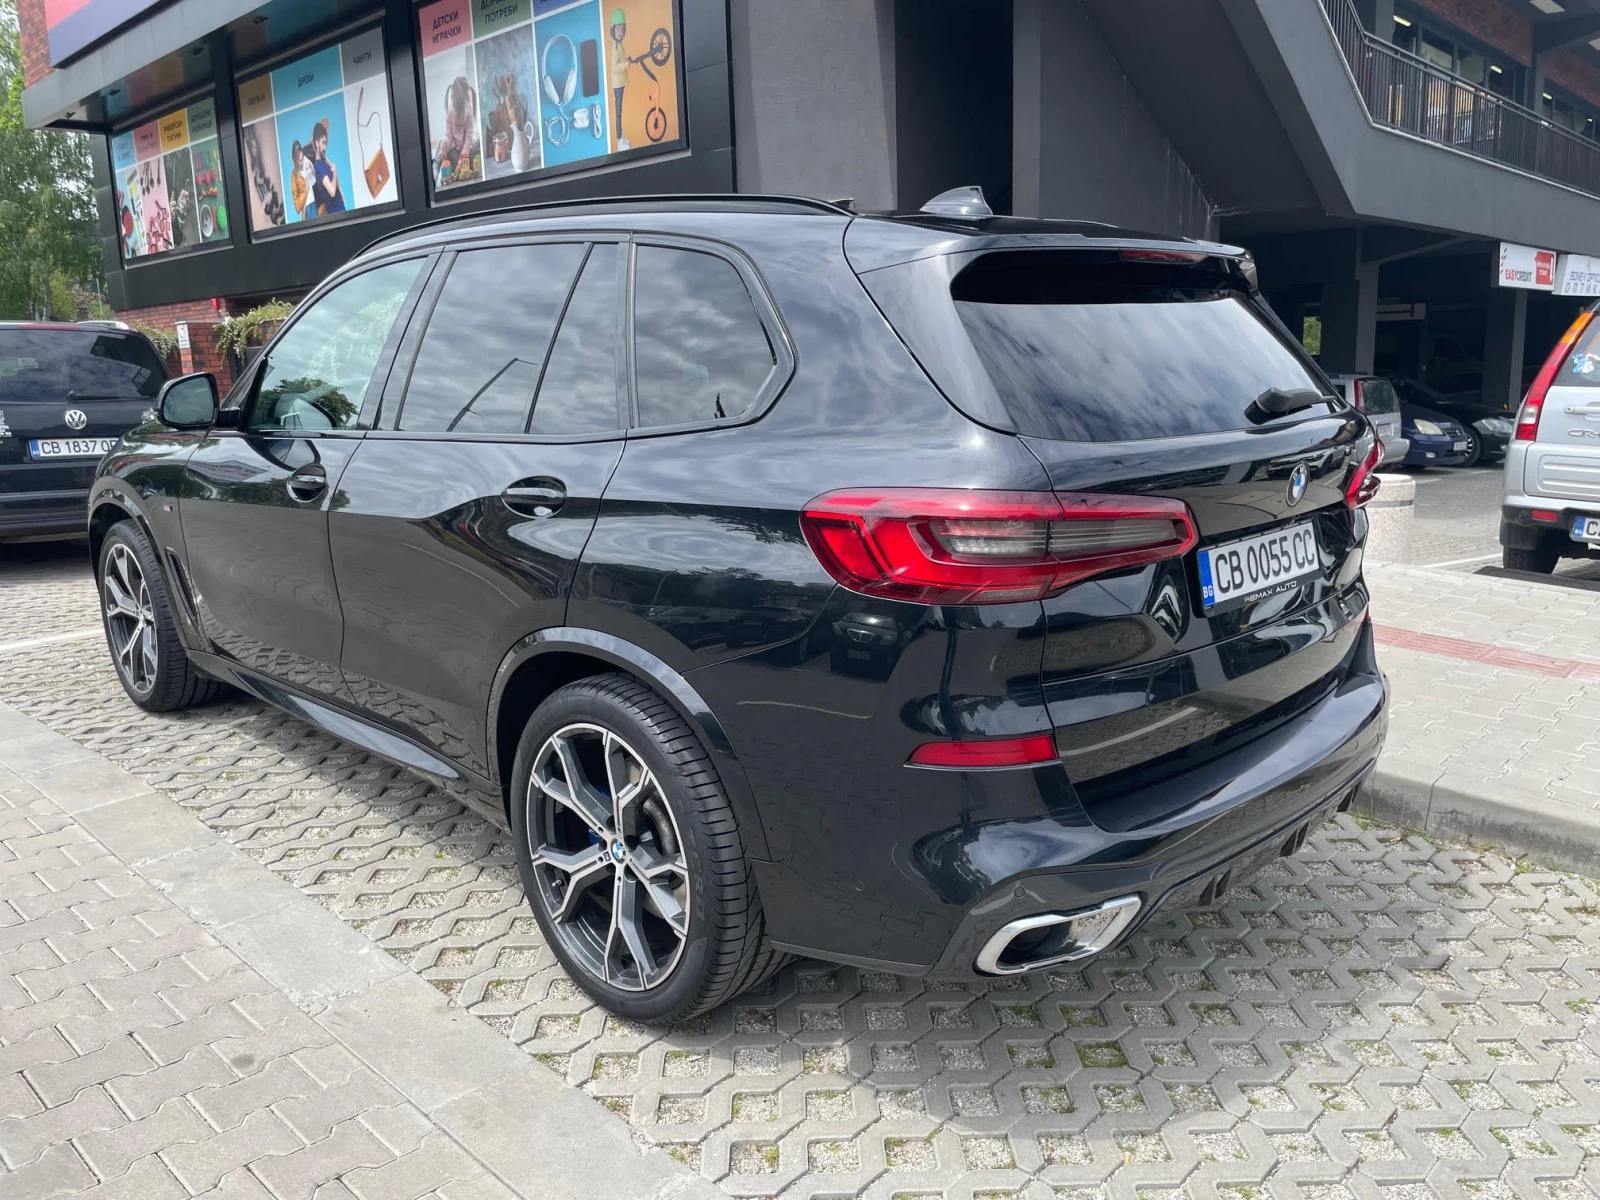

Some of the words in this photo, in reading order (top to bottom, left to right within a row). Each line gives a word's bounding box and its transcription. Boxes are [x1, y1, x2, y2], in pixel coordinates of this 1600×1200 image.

[432, 12, 459, 30] ДЕТСКИ
[484, 3, 518, 24] ПОТРЕБИ
[431, 25, 462, 44] ИГРАЧКИ
[352, 51, 372, 65] ЧАНТИ
[298, 73, 315, 87] ДРЕХИ
[1505, 269, 1532, 283] EASYCREDIT
[41, 441, 61, 454] CB
[65, 440, 97, 454] 1837
[1215, 550, 1244, 593] CB
[1247, 535, 1292, 584] 0055
[1293, 529, 1315, 569] CC
[1203, 585, 1213, 599] BG
[1243, 588, 1273, 603] REMAX
[1275, 581, 1297, 593] AUTO
